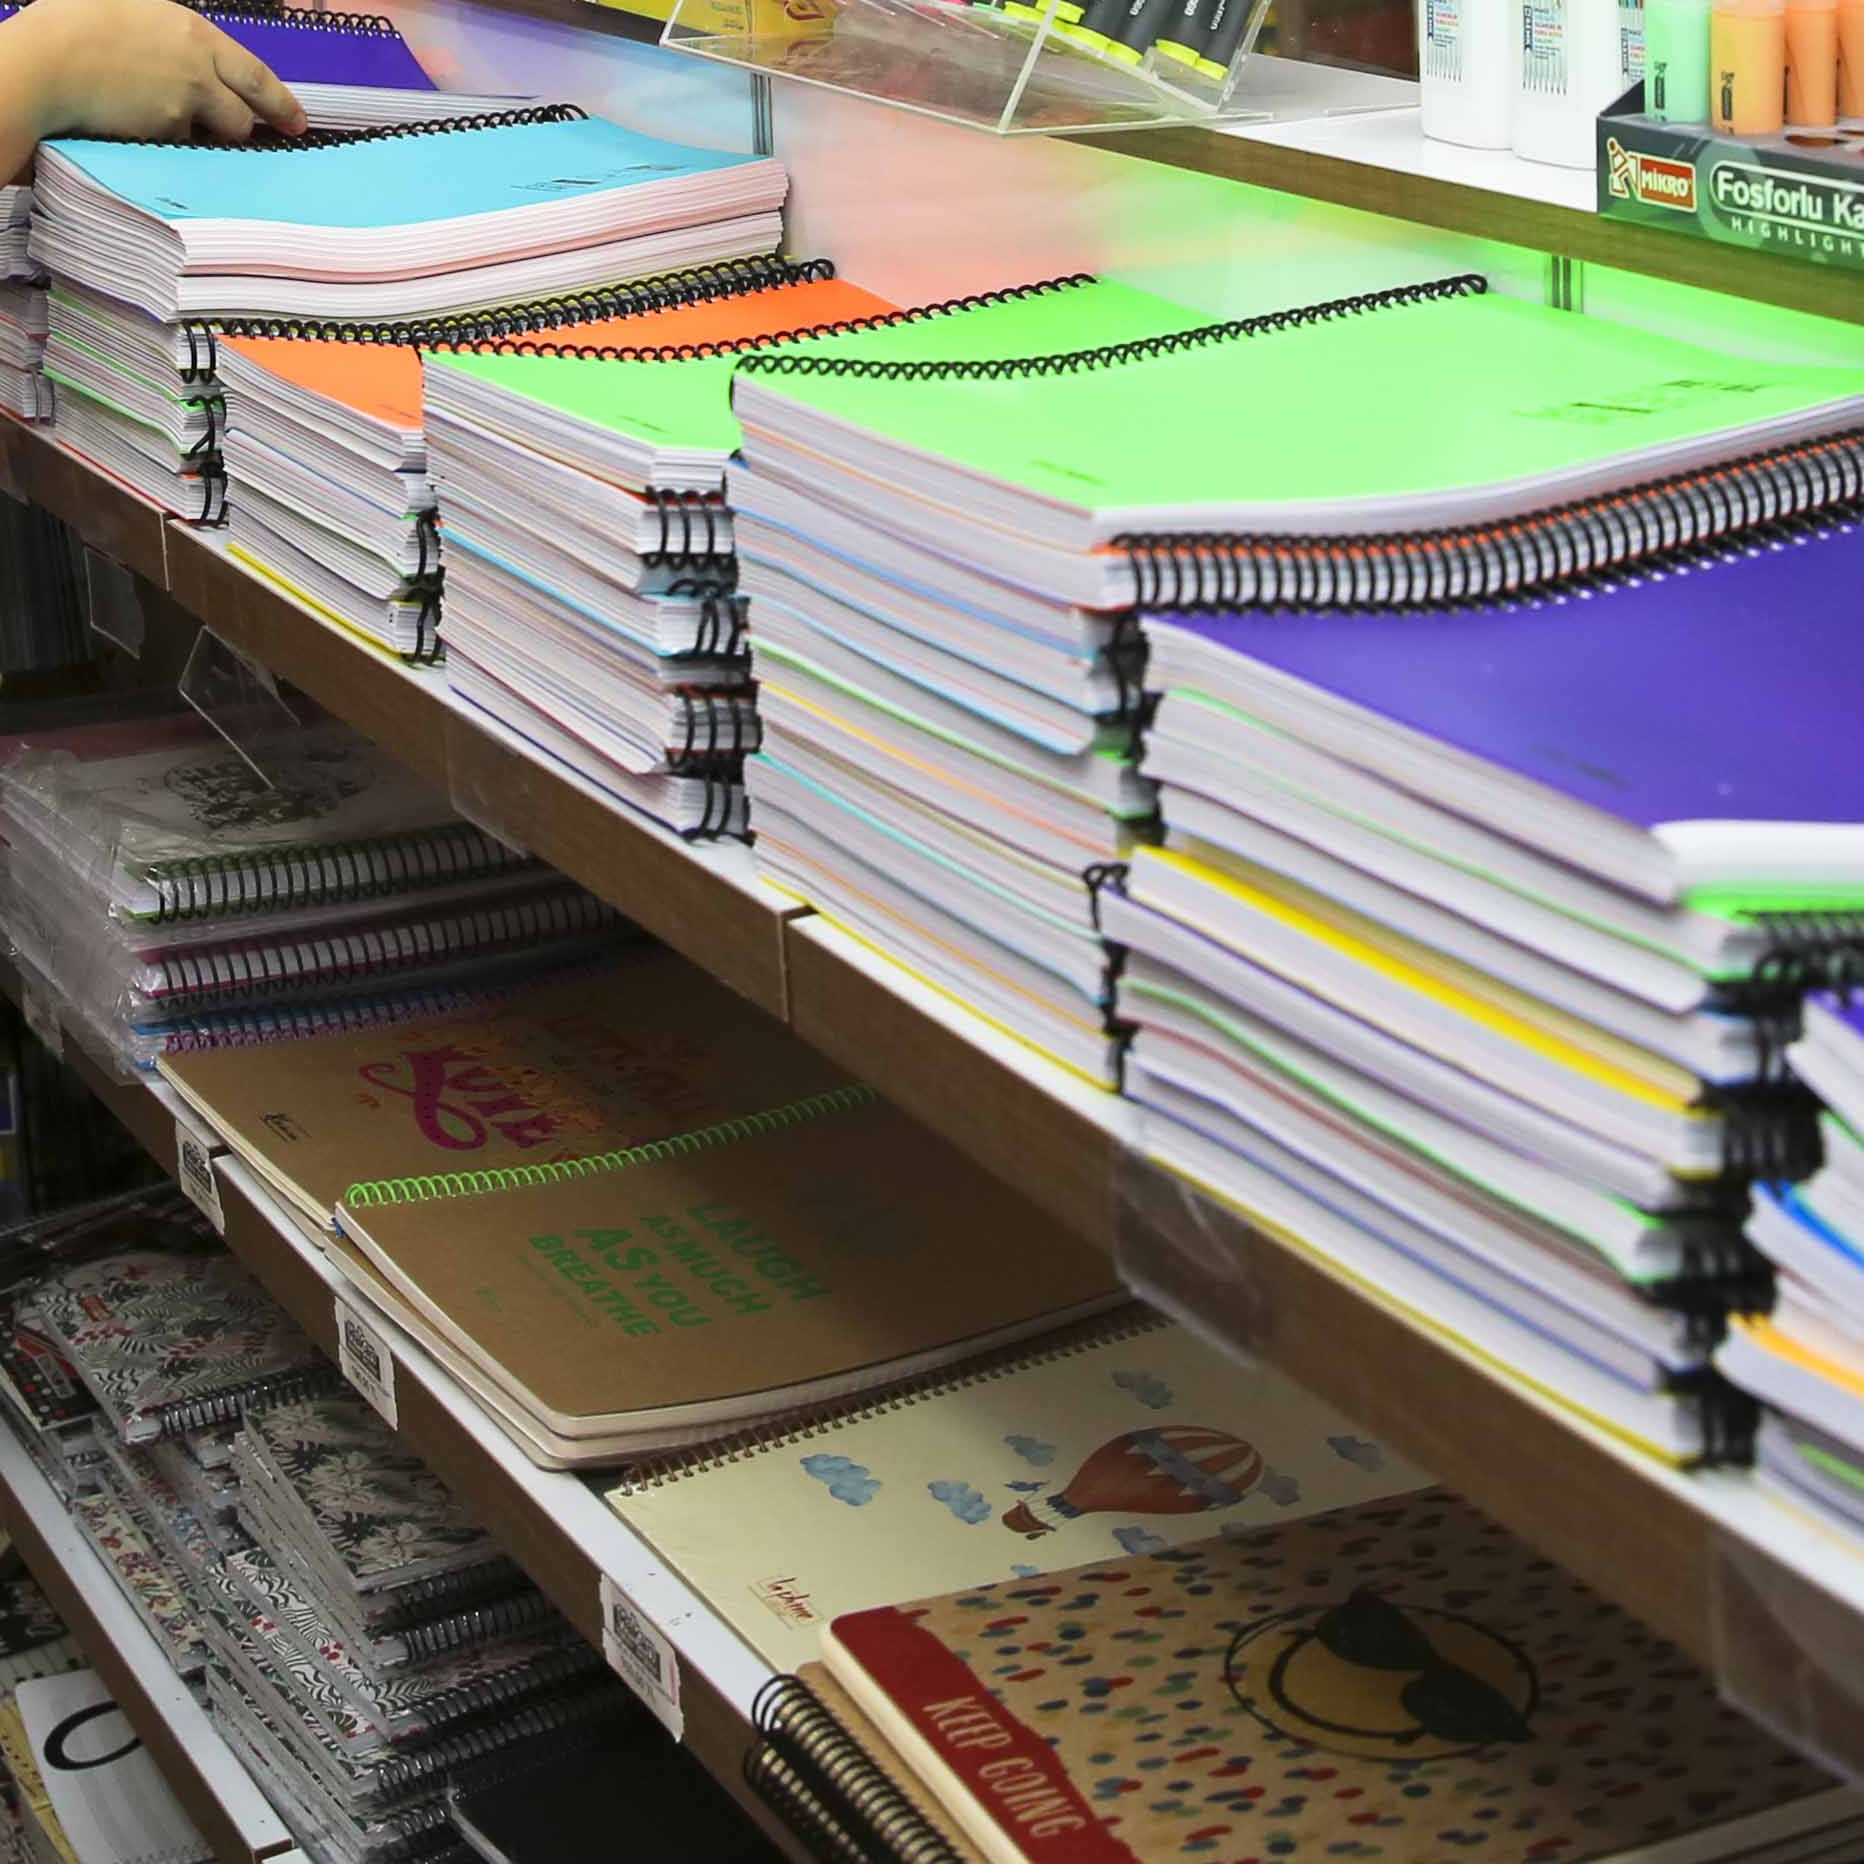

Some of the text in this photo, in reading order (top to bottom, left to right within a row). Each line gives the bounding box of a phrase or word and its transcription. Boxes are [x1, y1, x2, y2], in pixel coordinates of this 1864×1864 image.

[1640, 164, 1690, 199] MİKRO
[1717, 170, 1824, 223] Fosforlu
[530, 1234, 663, 1338] BREATHE
[685, 1202, 832, 1304] LAUGH
[634, 1272, 713, 1328] YOU
[924, 1696, 1086, 1843] KEEP GOING
